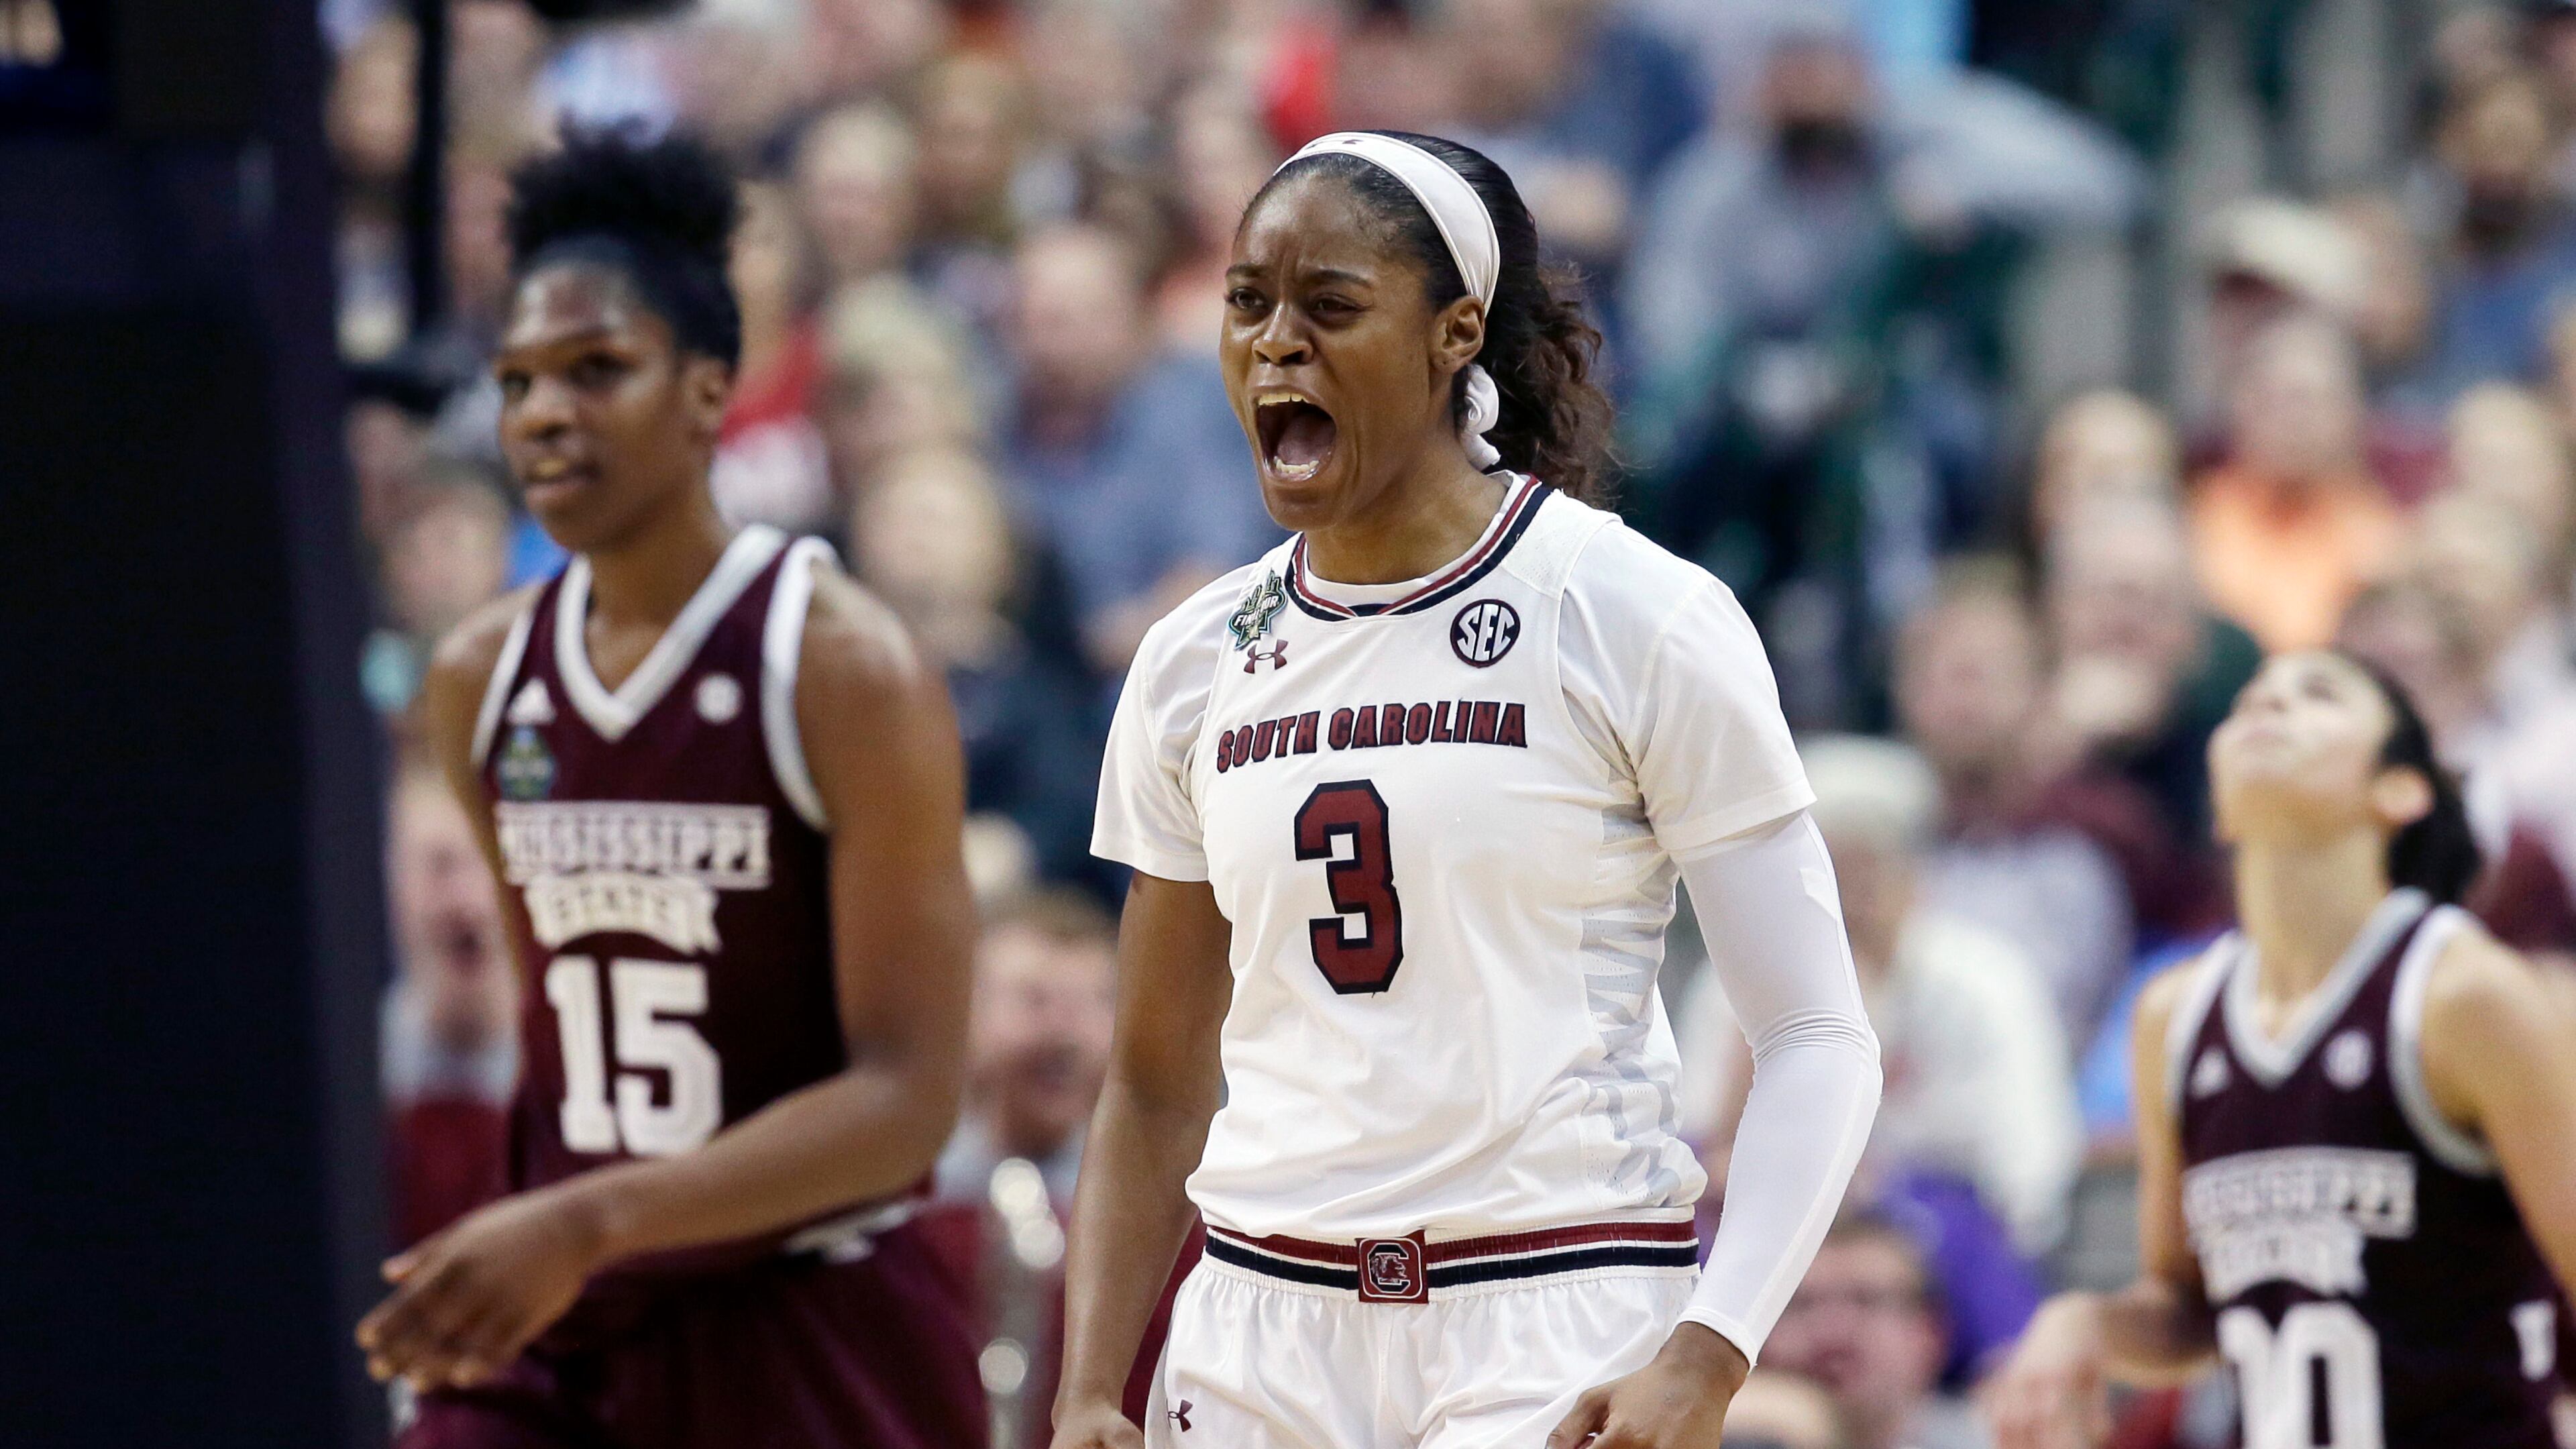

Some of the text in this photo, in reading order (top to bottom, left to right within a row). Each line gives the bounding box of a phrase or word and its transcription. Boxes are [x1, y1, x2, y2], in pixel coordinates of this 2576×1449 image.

[1456, 604, 1515, 661] SEC
[1217, 701, 1527, 773] SOUTH CAROLINA
[1295, 779, 1404, 995] 3
[545, 956, 723, 1154] 15
